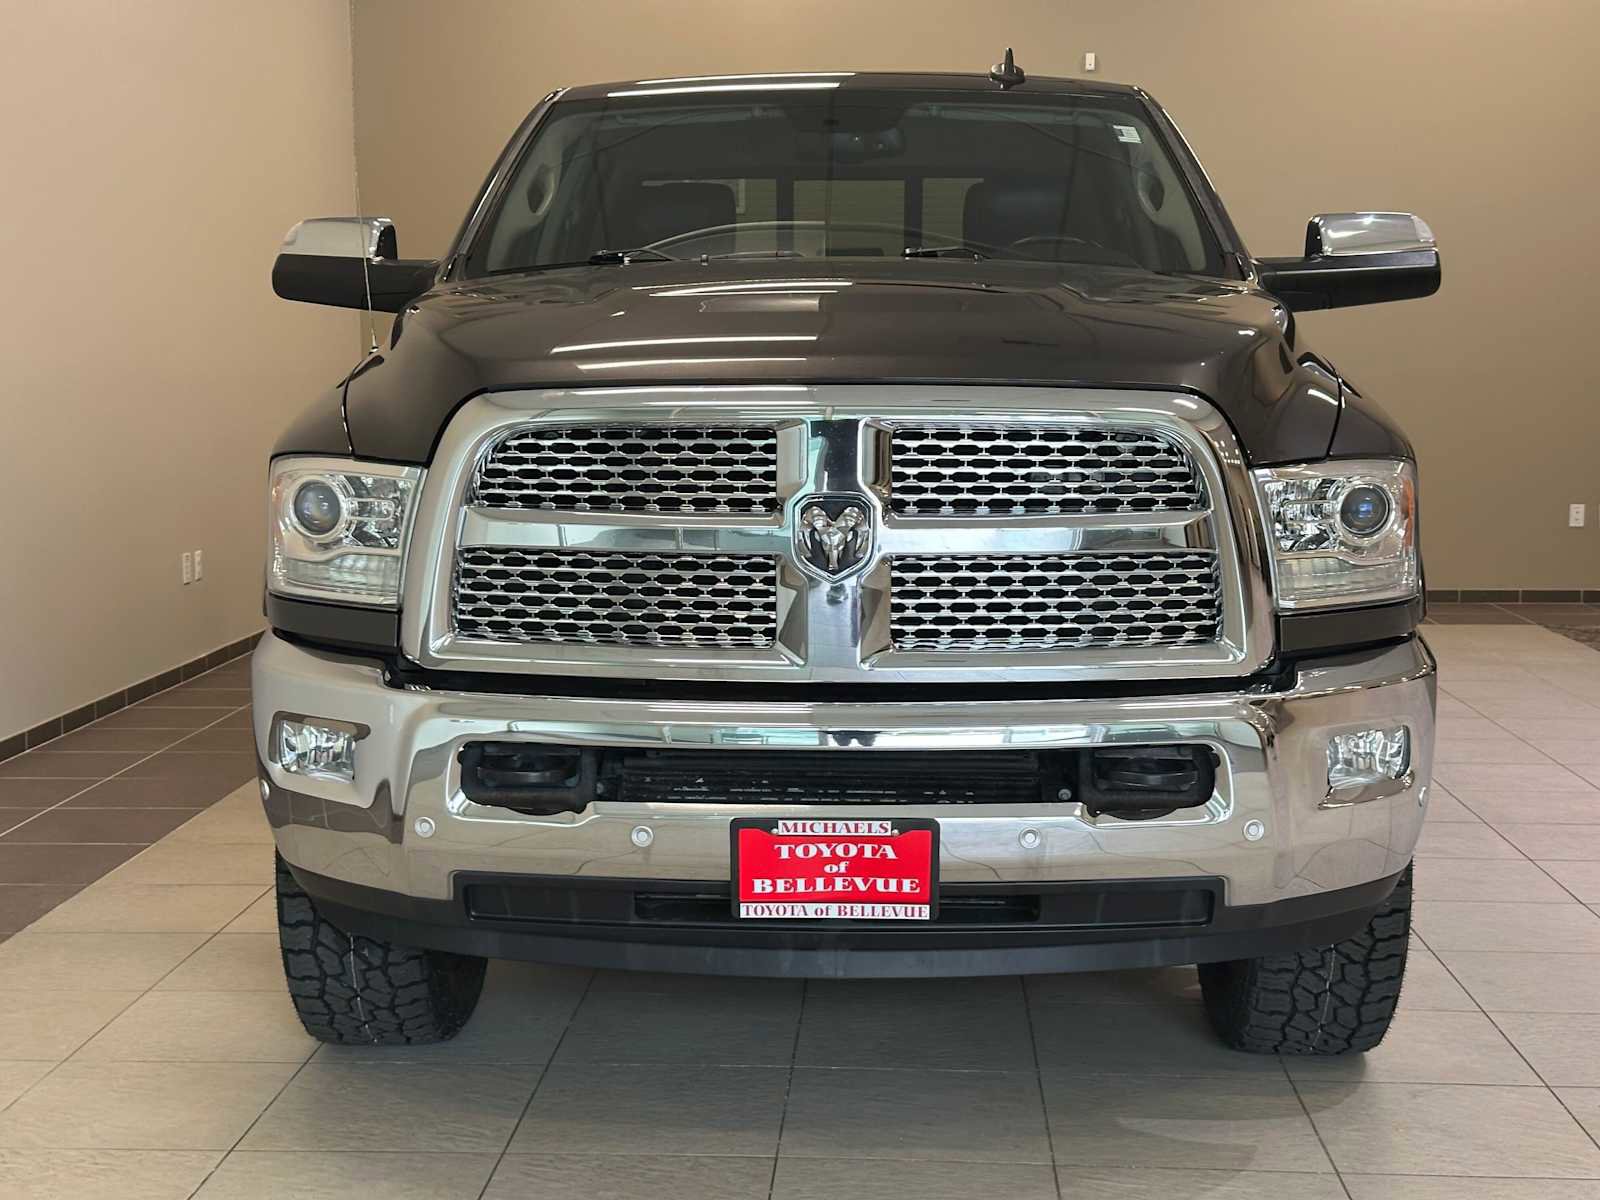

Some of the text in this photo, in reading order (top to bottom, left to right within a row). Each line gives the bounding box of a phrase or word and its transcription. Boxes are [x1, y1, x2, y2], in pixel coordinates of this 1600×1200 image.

[780, 822, 889, 833] MICHAELS
[774, 843, 898, 859] TOYOTA
[823, 861, 849, 873] of
[752, 877, 920, 893] BELLEVUE
[744, 905, 928, 918] TOYOTA of BELLEVUE
